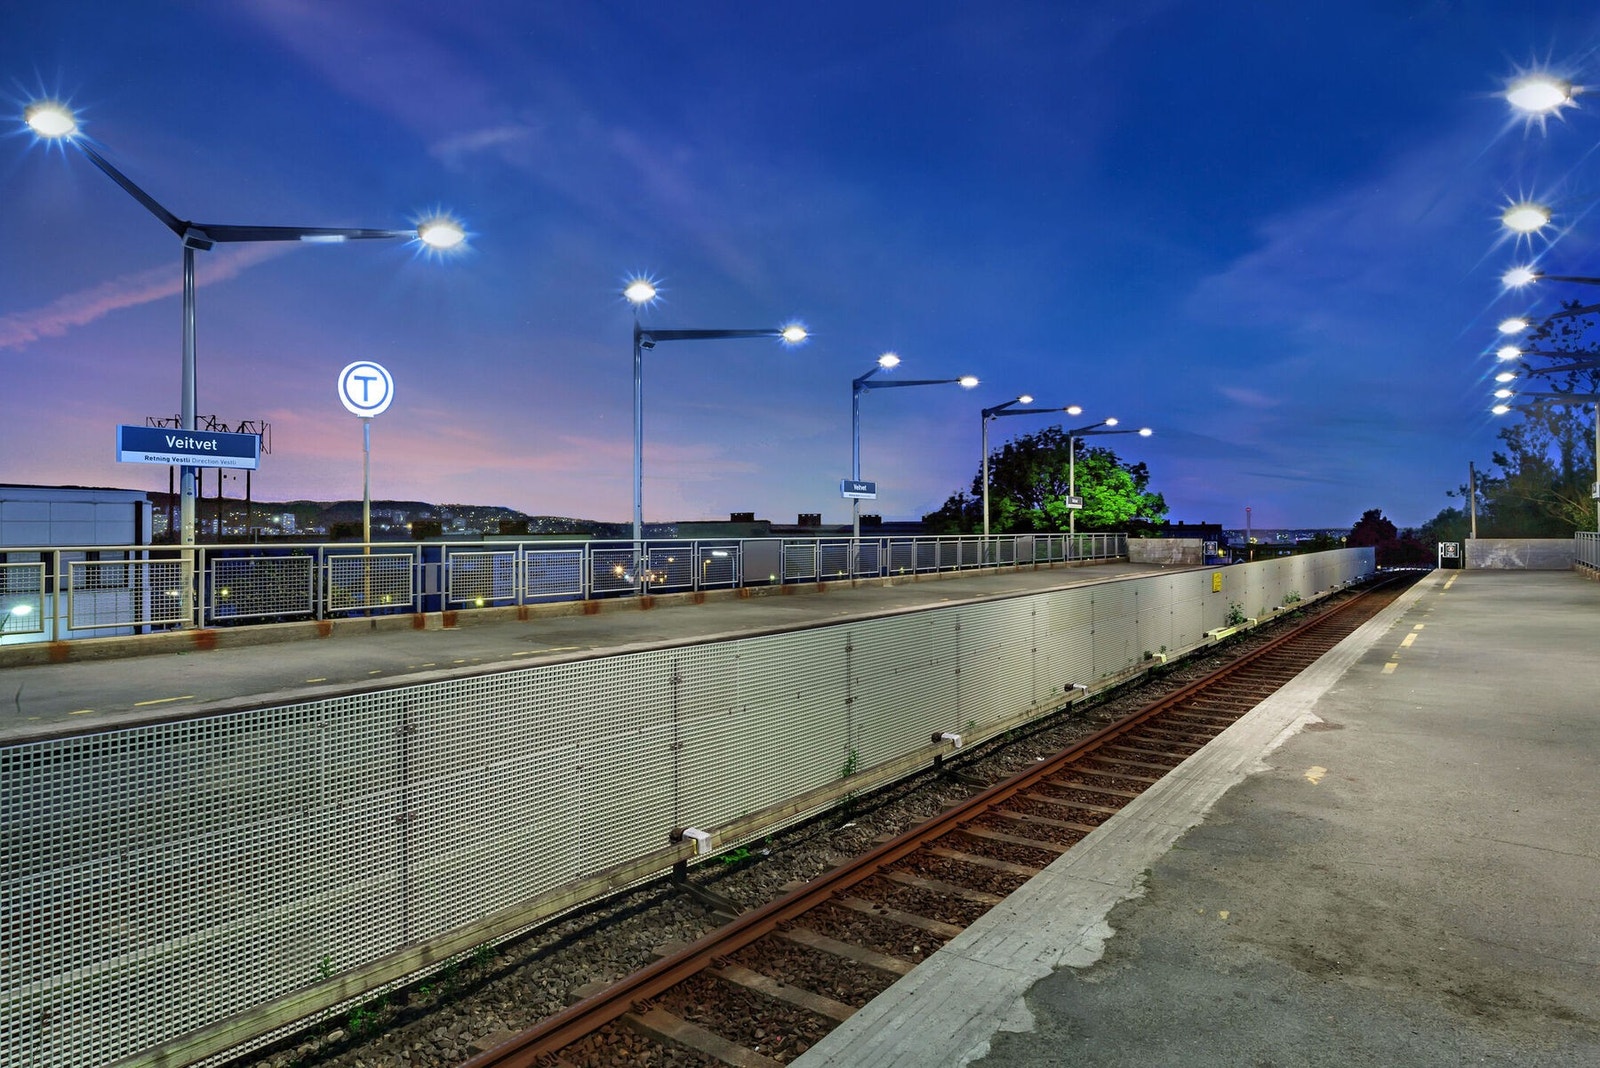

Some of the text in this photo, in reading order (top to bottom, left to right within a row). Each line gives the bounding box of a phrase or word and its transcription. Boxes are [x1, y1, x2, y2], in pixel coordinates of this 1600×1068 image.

[354, 376, 377, 402] T
[165, 435, 218, 451] Veitvet
[144, 455, 171, 463] Retning
[191, 457, 220, 465] Direction
